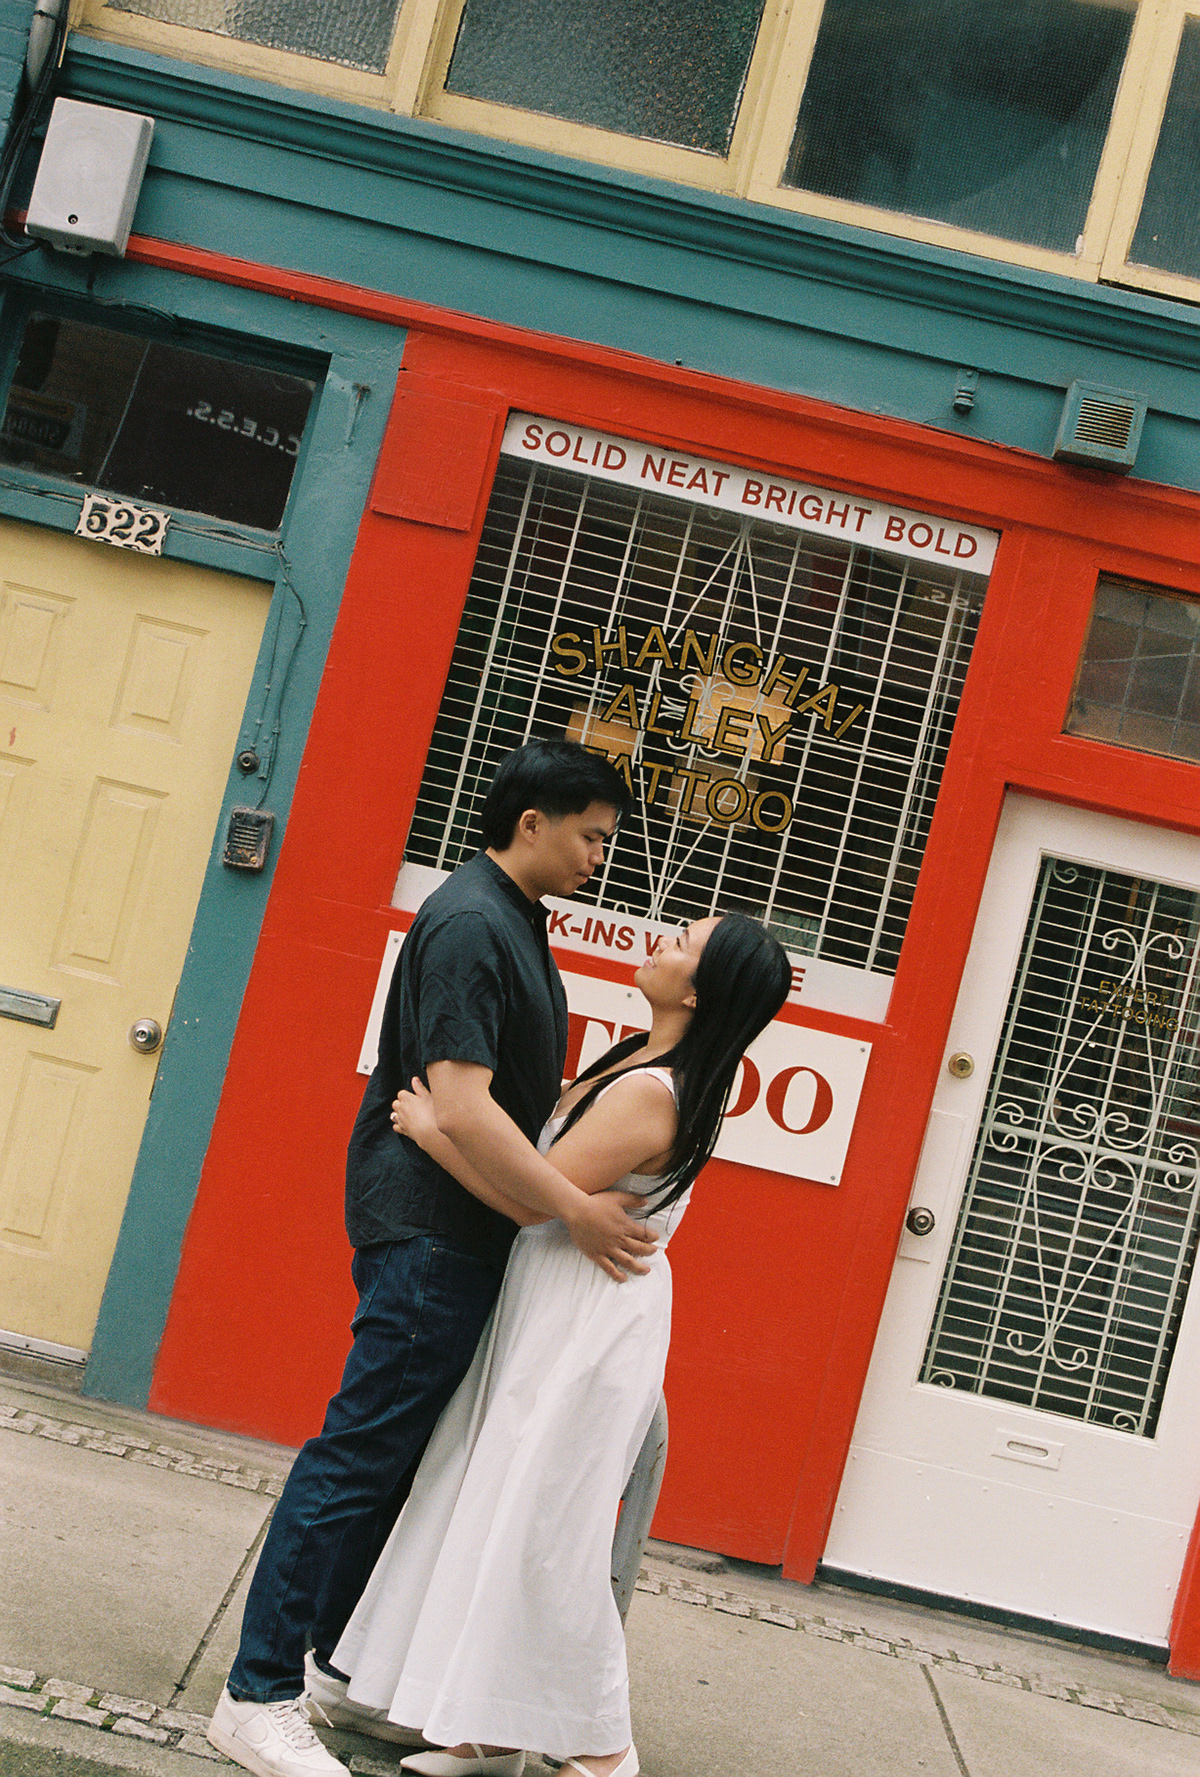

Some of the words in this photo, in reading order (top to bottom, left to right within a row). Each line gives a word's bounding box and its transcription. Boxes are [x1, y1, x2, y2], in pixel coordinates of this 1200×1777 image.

[522, 424, 627, 471] SOLID
[640, 454, 730, 497] NEAT
[741, 480, 872, 533] BRIGHT
[884, 515, 978, 559] BOLD
[86, 502, 160, 548] 522
[551, 625, 865, 740] SHANGHAI
[600, 683, 793, 762] ALLEY
[1080, 996, 1179, 1031] TATTOOING
[1098, 980, 1170, 1008] EXPERT
